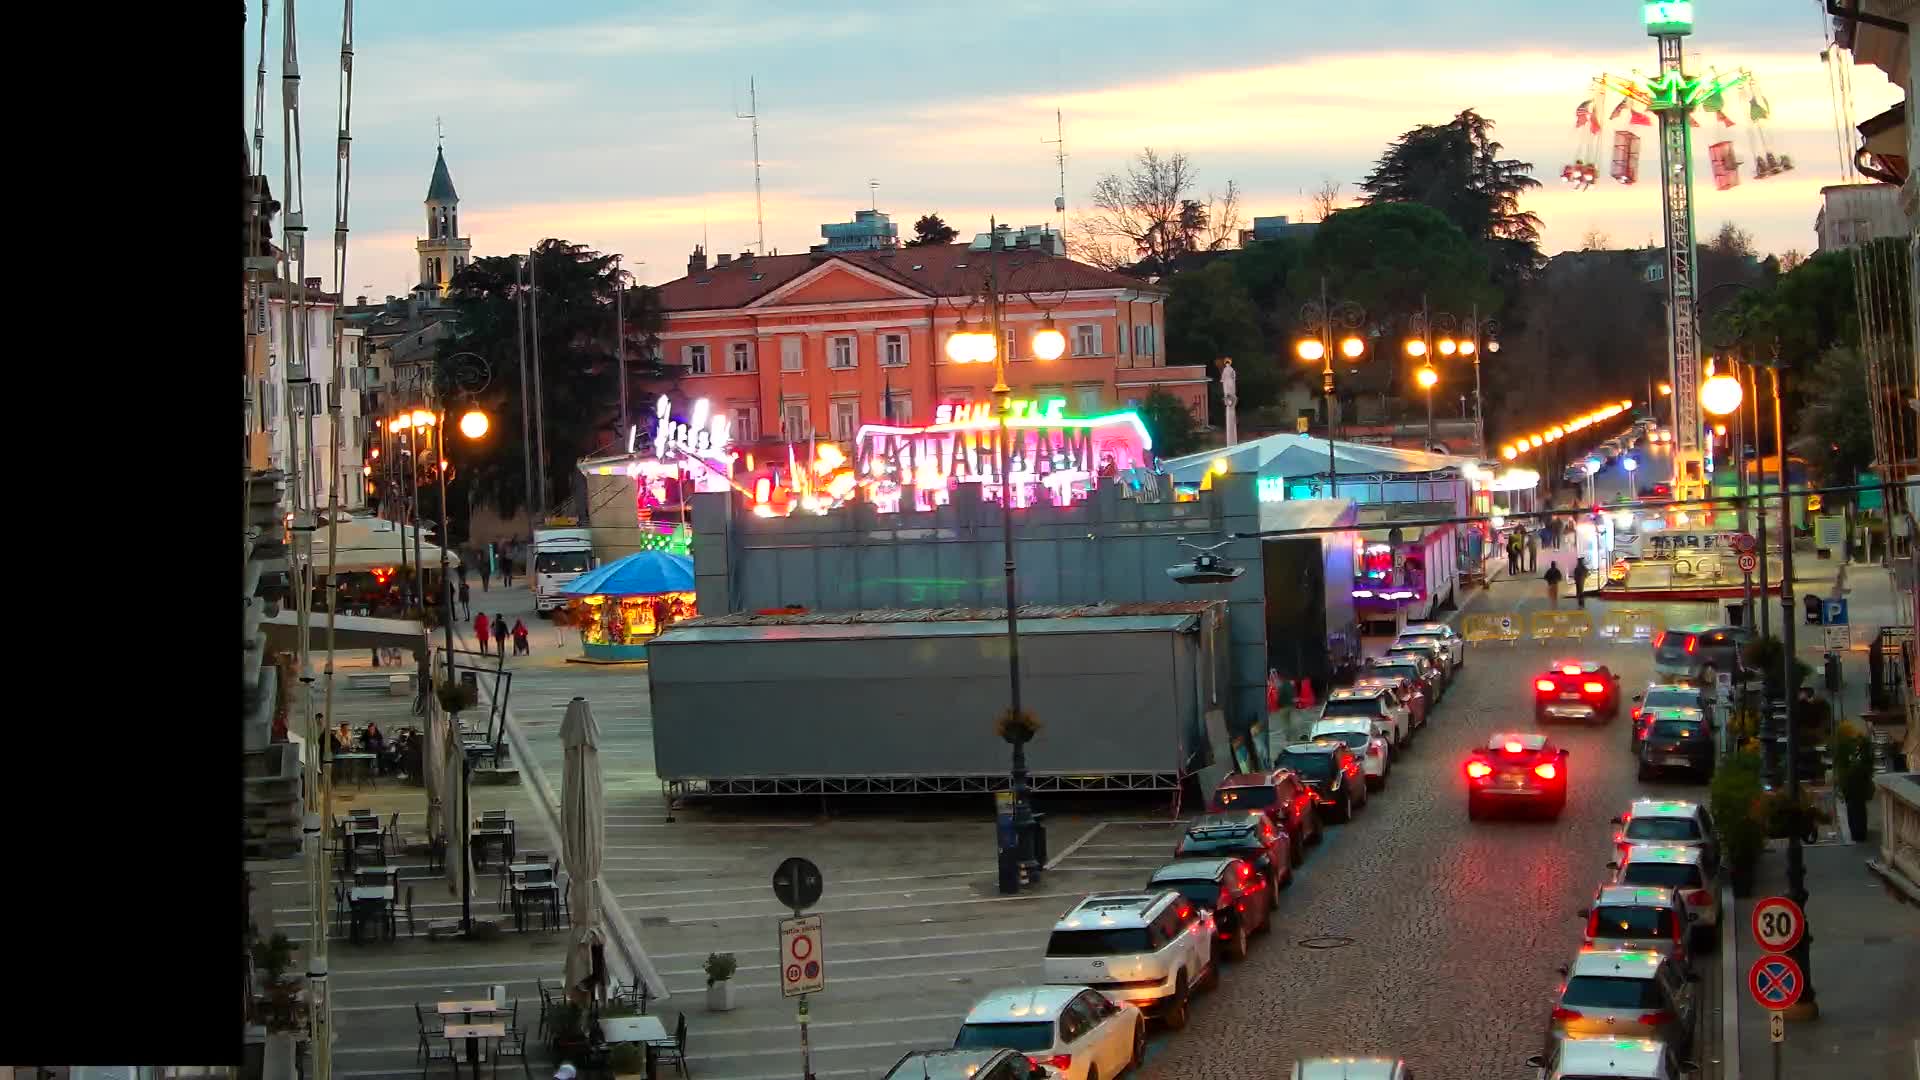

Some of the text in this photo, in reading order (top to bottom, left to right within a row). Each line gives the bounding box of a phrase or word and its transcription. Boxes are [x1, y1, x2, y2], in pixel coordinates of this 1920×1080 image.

[1743, 558, 1752, 567] 20
[1828, 603, 1842, 622] P
[1762, 911, 1791, 938] 30
